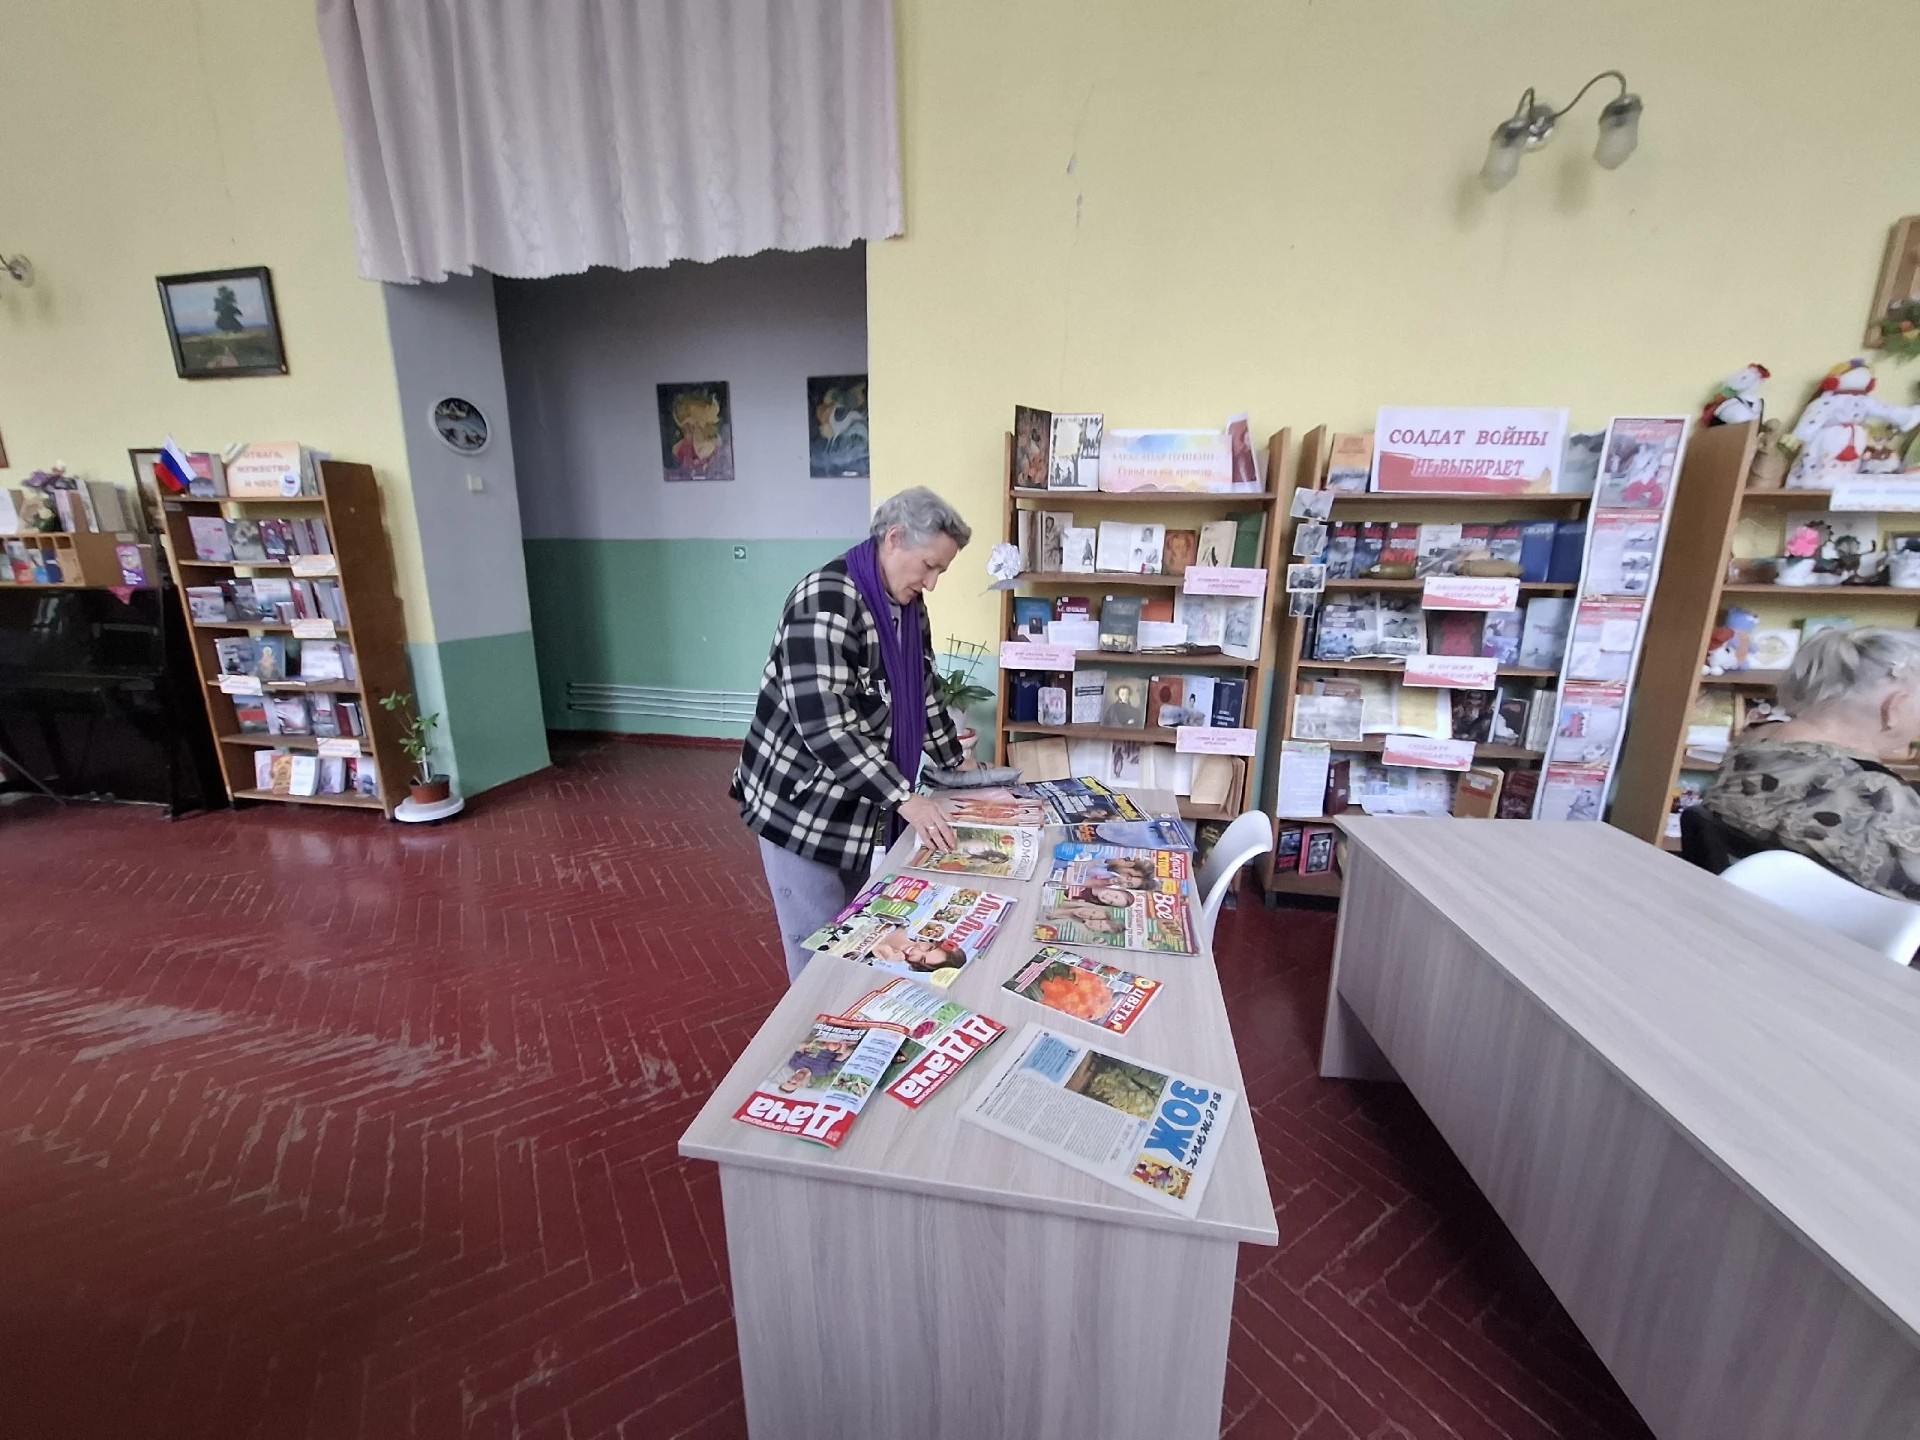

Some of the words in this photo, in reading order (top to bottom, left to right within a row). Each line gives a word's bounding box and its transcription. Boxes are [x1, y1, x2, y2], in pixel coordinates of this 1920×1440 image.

[1389, 429, 1465, 447] СОЛДАТ
[1475, 426, 1549, 446] ВОЙНЫ
[1415, 459, 1436, 475] НЕ
[1438, 459, 1525, 476] ВЫБИРАЕТ
[1152, 891, 1175, 920] Все
[942, 915, 985, 952] Лиза
[1110, 988, 1146, 1026] ЦВЕТЫ
[894, 1031, 974, 1099] Дача
[746, 1096, 848, 1139] Дача
[1144, 1080, 1209, 1162] ЗОЖ
[1185, 1091, 1222, 1169] ВЕСТНИК
